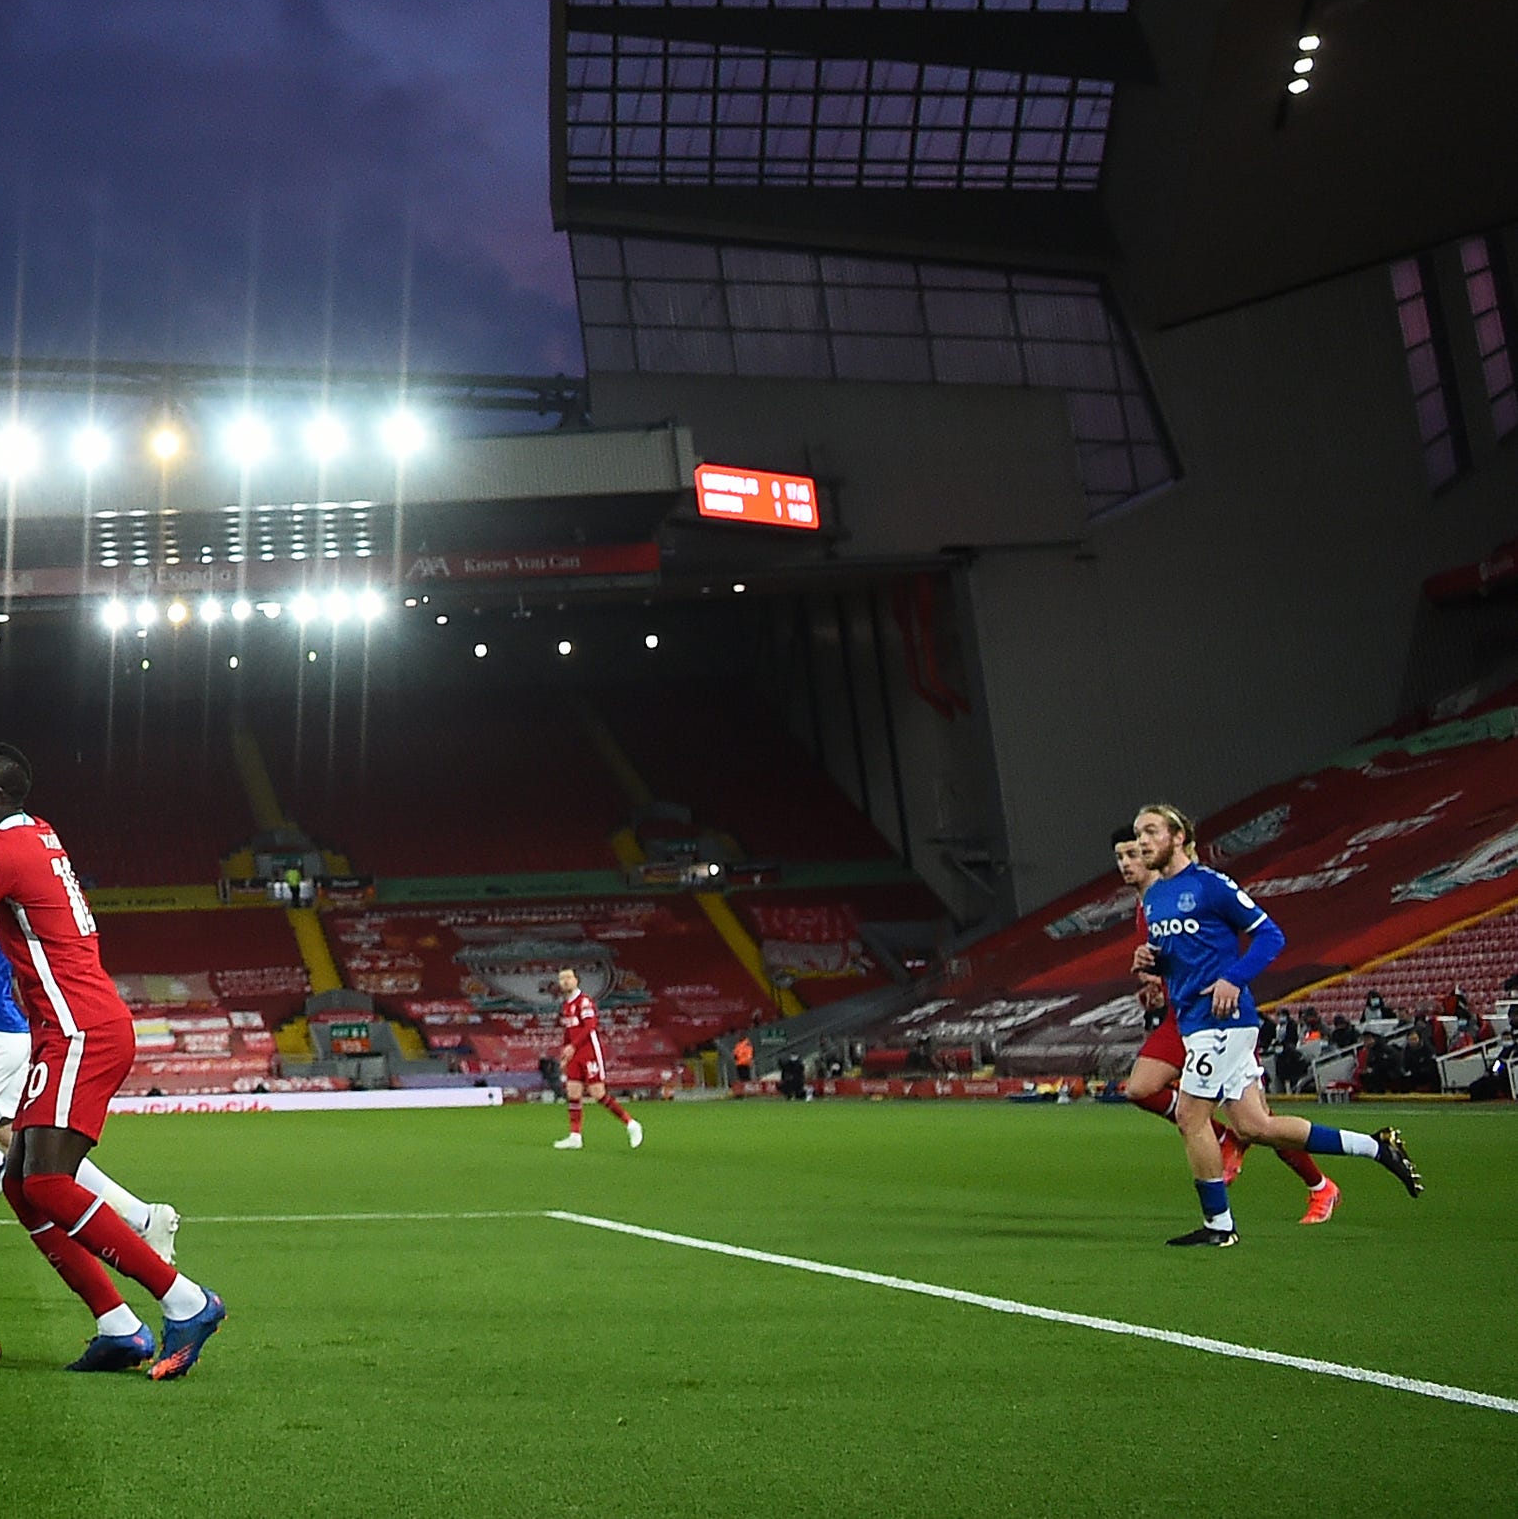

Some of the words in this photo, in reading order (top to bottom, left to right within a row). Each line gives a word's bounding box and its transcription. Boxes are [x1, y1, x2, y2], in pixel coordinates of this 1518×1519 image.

[776, 501, 782, 518] 1
[405, 557, 451, 579] AXA
[464, 558, 510, 574] Know
[514, 556, 547, 571] You
[550, 556, 581, 570] Can
[1184, 1048, 1214, 1078] 26
